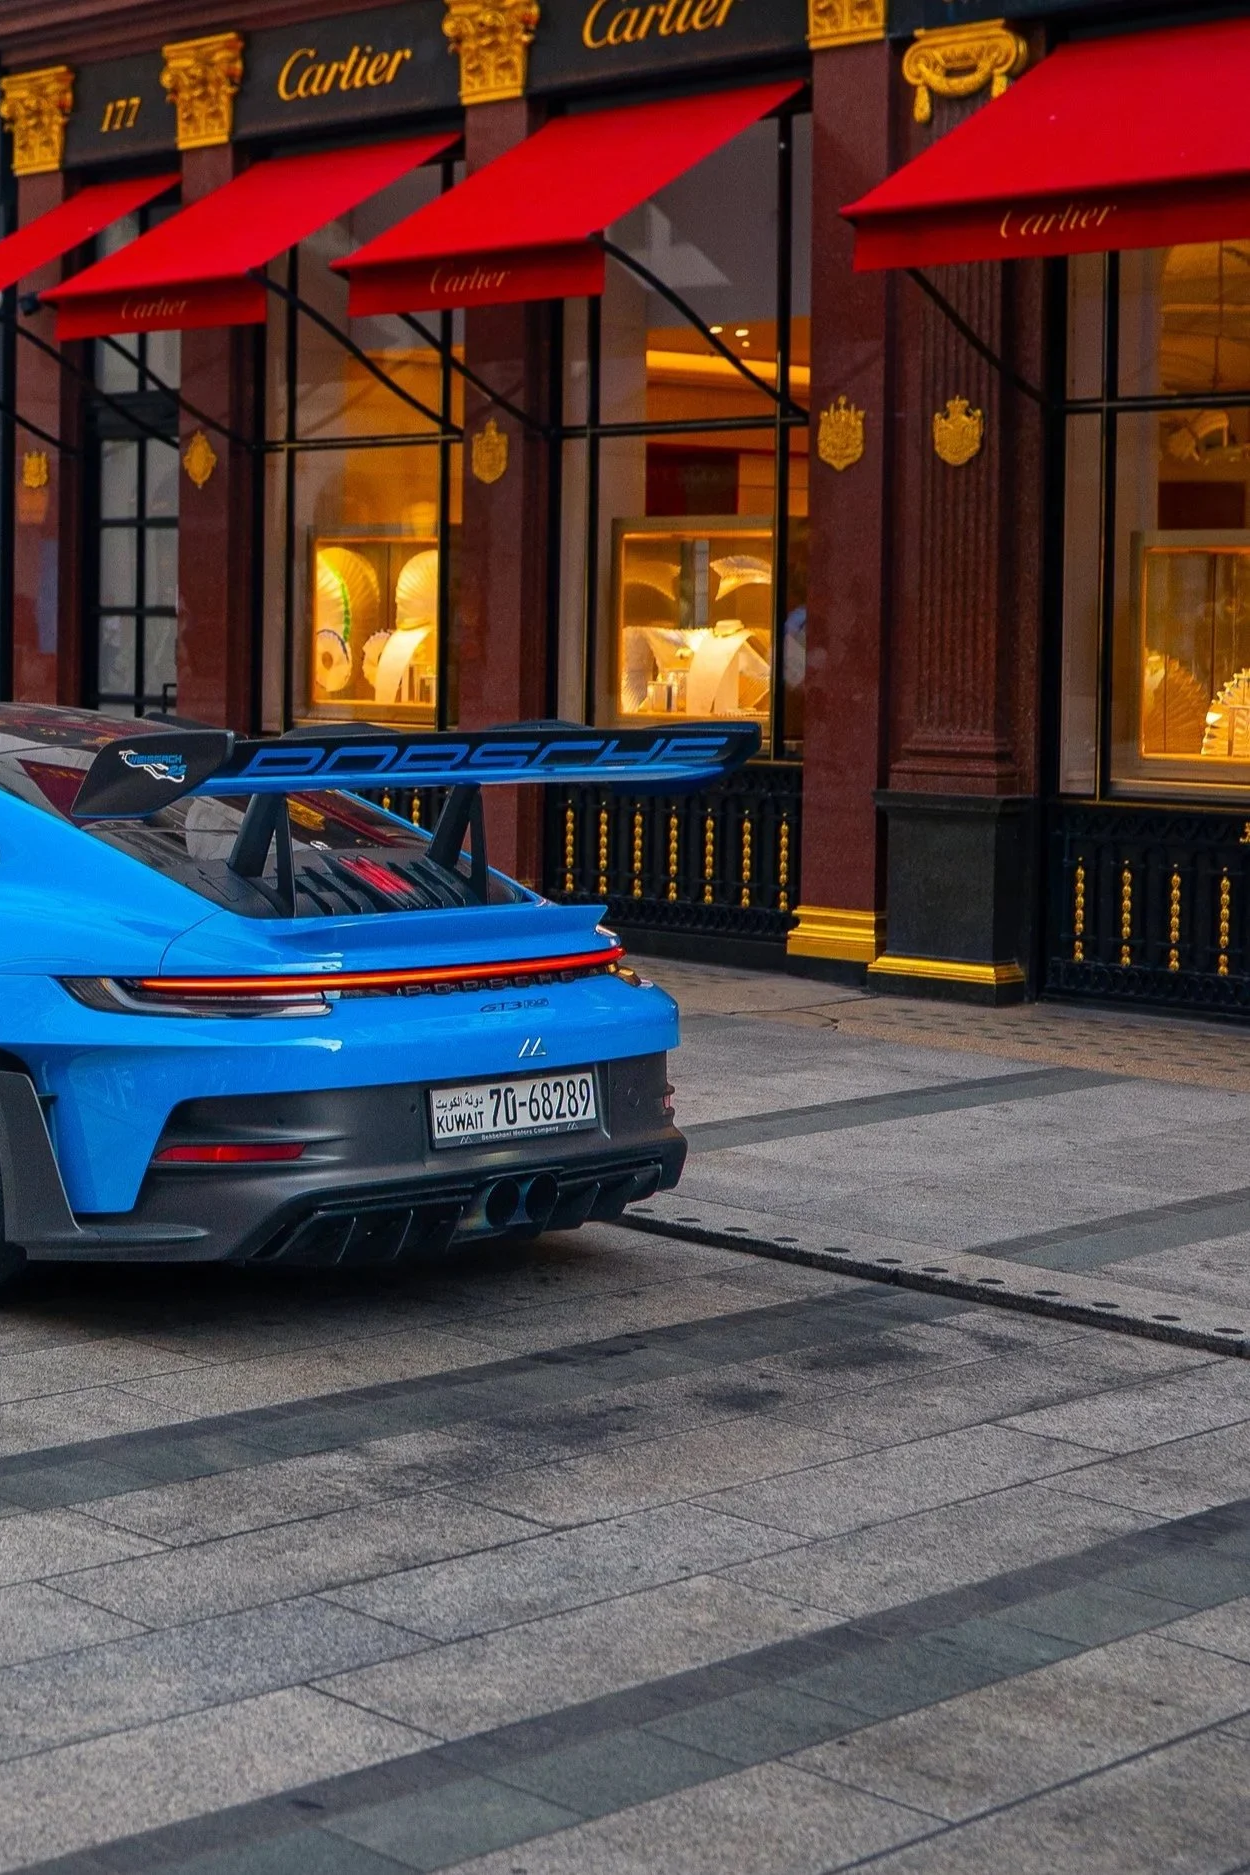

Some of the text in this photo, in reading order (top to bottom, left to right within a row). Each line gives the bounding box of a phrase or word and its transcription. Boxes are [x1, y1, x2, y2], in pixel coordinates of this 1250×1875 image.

[582, 0, 738, 49] Cartier
[278, 45, 412, 101] Cartier
[100, 96, 141, 133] 177
[1000, 204, 1117, 239] Cartier
[430, 262, 511, 295] Cartier
[121, 296, 190, 320] Cartier
[128, 753, 183, 765] WEISSACH
[238, 737, 729, 777] PORSCHE
[406, 971, 575, 994] PORSCHE
[489, 1078, 591, 1128] 70-68289
[436, 1111, 485, 1134] KUWAIT
[513, 1128, 533, 1137] Motors
[533, 1125, 559, 1135] Company
